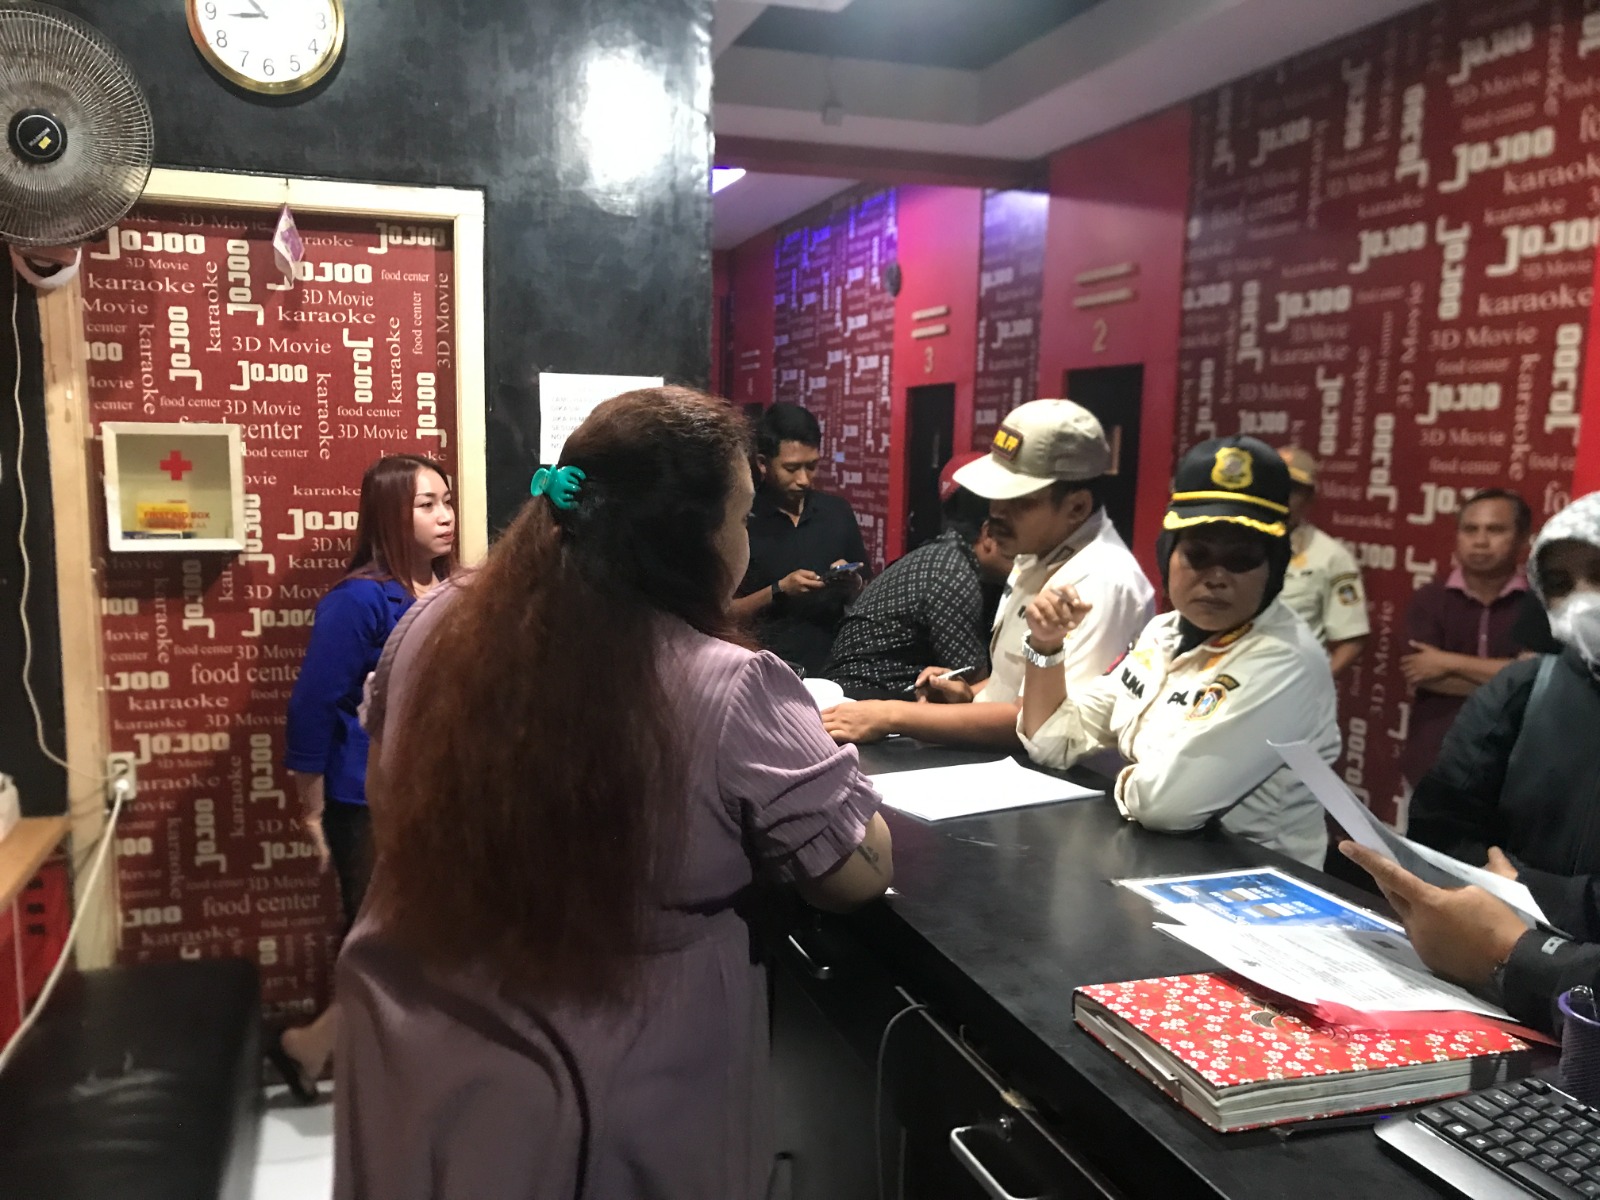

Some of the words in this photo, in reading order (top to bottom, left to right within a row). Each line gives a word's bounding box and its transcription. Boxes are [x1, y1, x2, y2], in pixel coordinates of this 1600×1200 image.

[204, 2, 217, 20] 9
[316, 13, 327, 30] 3
[216, 29, 228, 48] 8
[308, 39, 319, 55] 4
[240, 50, 250, 67] 7
[263, 58, 275, 76] 6
[289, 54, 301, 72] 5
[1502, 152, 1600, 196] karaok
[304, 235, 354, 247] raoke
[126, 257, 145, 267] 3D
[149, 258, 190, 271] Movie
[88, 273, 195, 294] karaoke
[381, 269, 401, 281] food
[403, 271, 430, 282] center
[81, 297, 149, 314] Movie
[203, 260, 223, 353] karaoke
[301, 288, 323, 304] 3D
[328, 290, 374, 307] Movie
[435, 272, 451, 335] Movie
[1477, 283, 1595, 317] karaoke
[278, 305, 377, 324] karaoke
[412, 291, 422, 327] center
[86, 323, 127, 333] center
[1091, 318, 1108, 353] 2
[231, 336, 261, 352] 3D
[269, 337, 332, 354] Movie
[411, 329, 423, 355] food
[386, 316, 403, 405] karaoke
[436, 340, 451, 369] 3D
[138, 323, 159, 416] karaoke
[94, 399, 135, 411] center
[160, 396, 185, 407] food
[187, 398, 221, 408] center
[224, 399, 247, 415] 3D
[252, 400, 301, 416] Movie
[316, 372, 334, 460] karaoke
[337, 406, 363, 417] food
[366, 408, 402, 417] center
[240, 420, 303, 440] center
[338, 424, 359, 440] 3D
[363, 424, 408, 440] Movie
[244, 448, 267, 458] ood
[271, 448, 309, 458] center
[244, 471, 277, 485] ovie
[293, 485, 361, 496] karaoke
[311, 537, 333, 552] 3D
[288, 554, 348, 569] kara
[243, 584, 273, 600] 3D
[279, 583, 330, 599] Movi
[235, 644, 259, 660] 3D
[190, 662, 240, 684] food
[246, 665, 301, 682] cente
[128, 693, 230, 711] karaoke
[114, 717, 188, 731] karaoke
[205, 714, 230, 728] 3D
[136, 773, 221, 792] araoke
[202, 894, 251, 917] food
[256, 893, 321, 912] center
